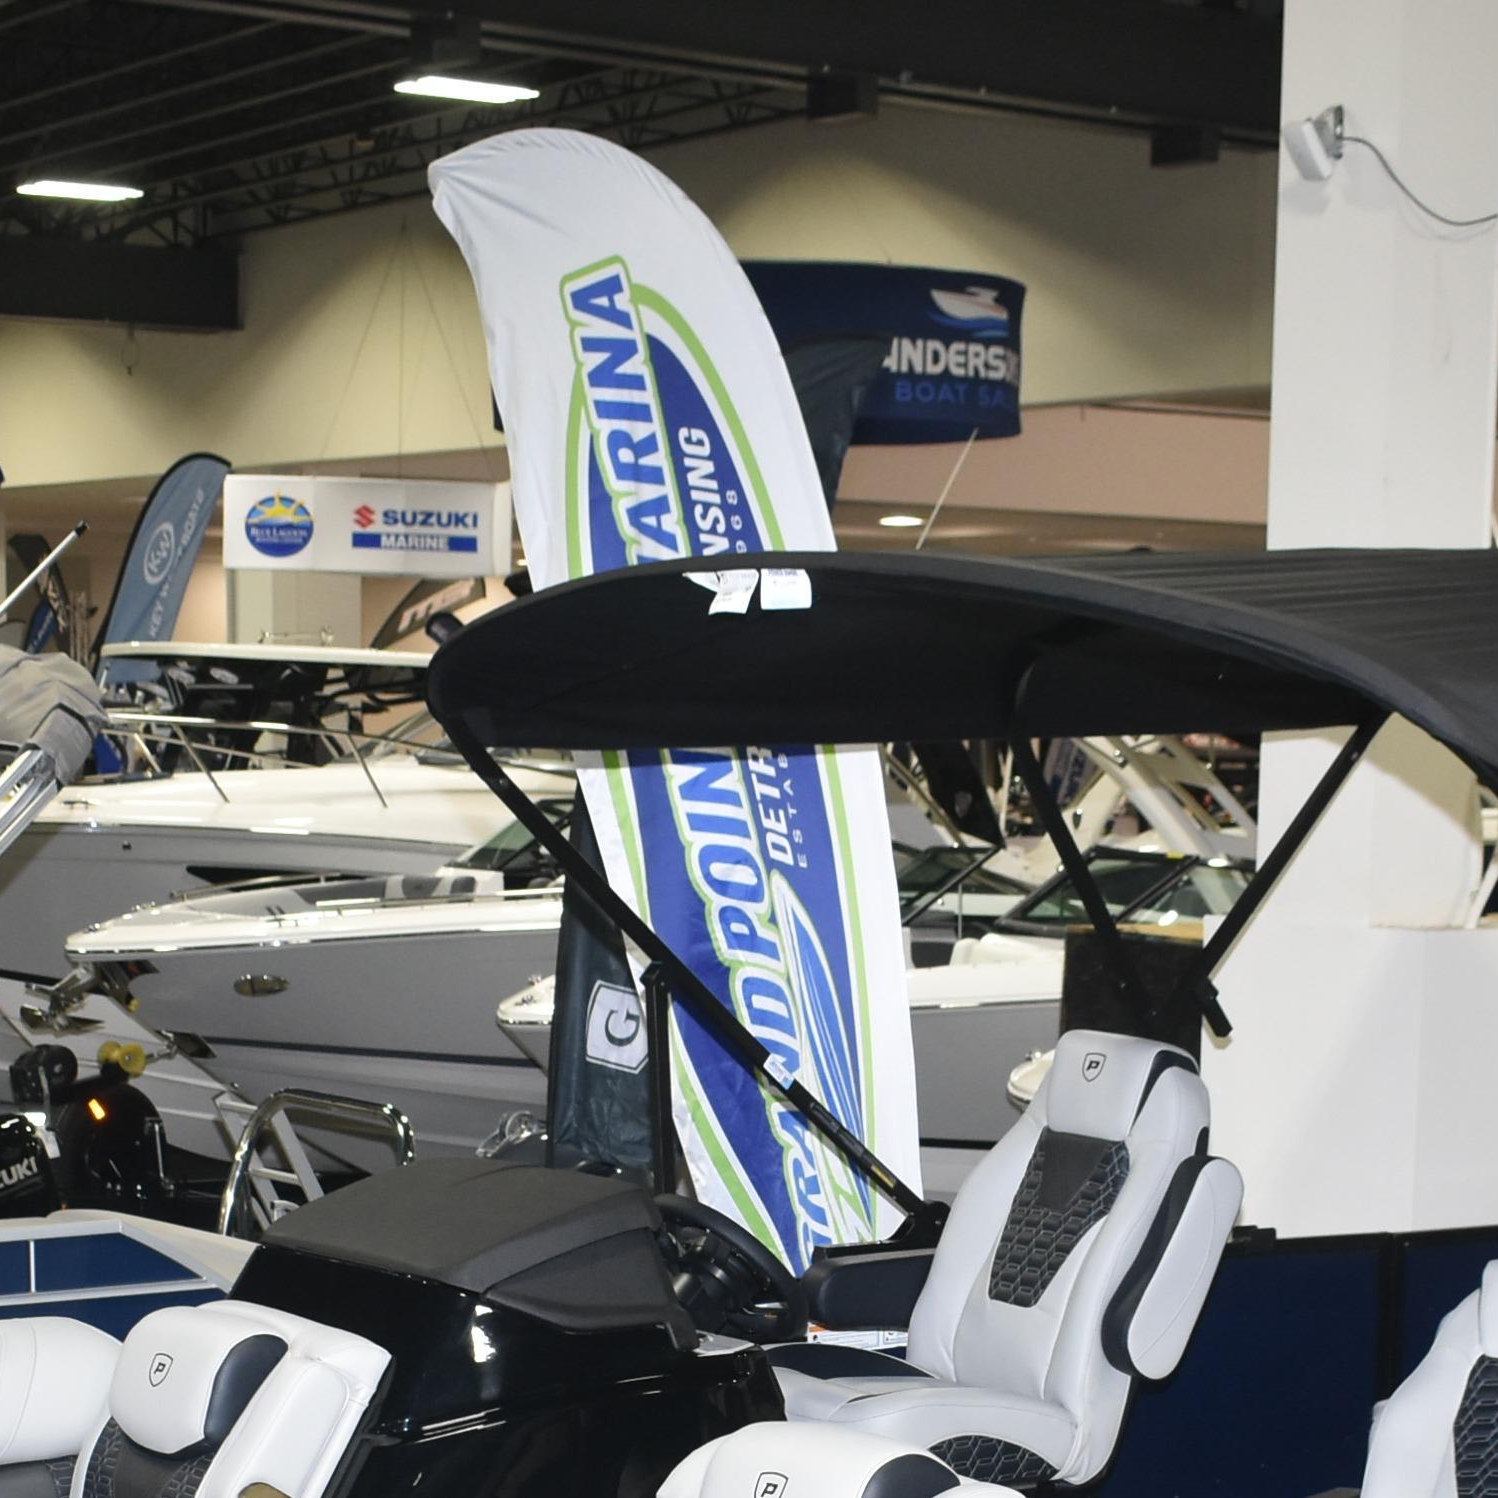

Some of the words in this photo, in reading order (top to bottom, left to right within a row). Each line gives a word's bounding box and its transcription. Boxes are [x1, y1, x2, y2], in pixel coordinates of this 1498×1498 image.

[895, 378, 968, 406] BOAT
[570, 272, 681, 566] ARINA
[382, 509, 478, 529] SUZUKI
[380, 533, 450, 551] MARINE
[604, 1008, 641, 1048] G
